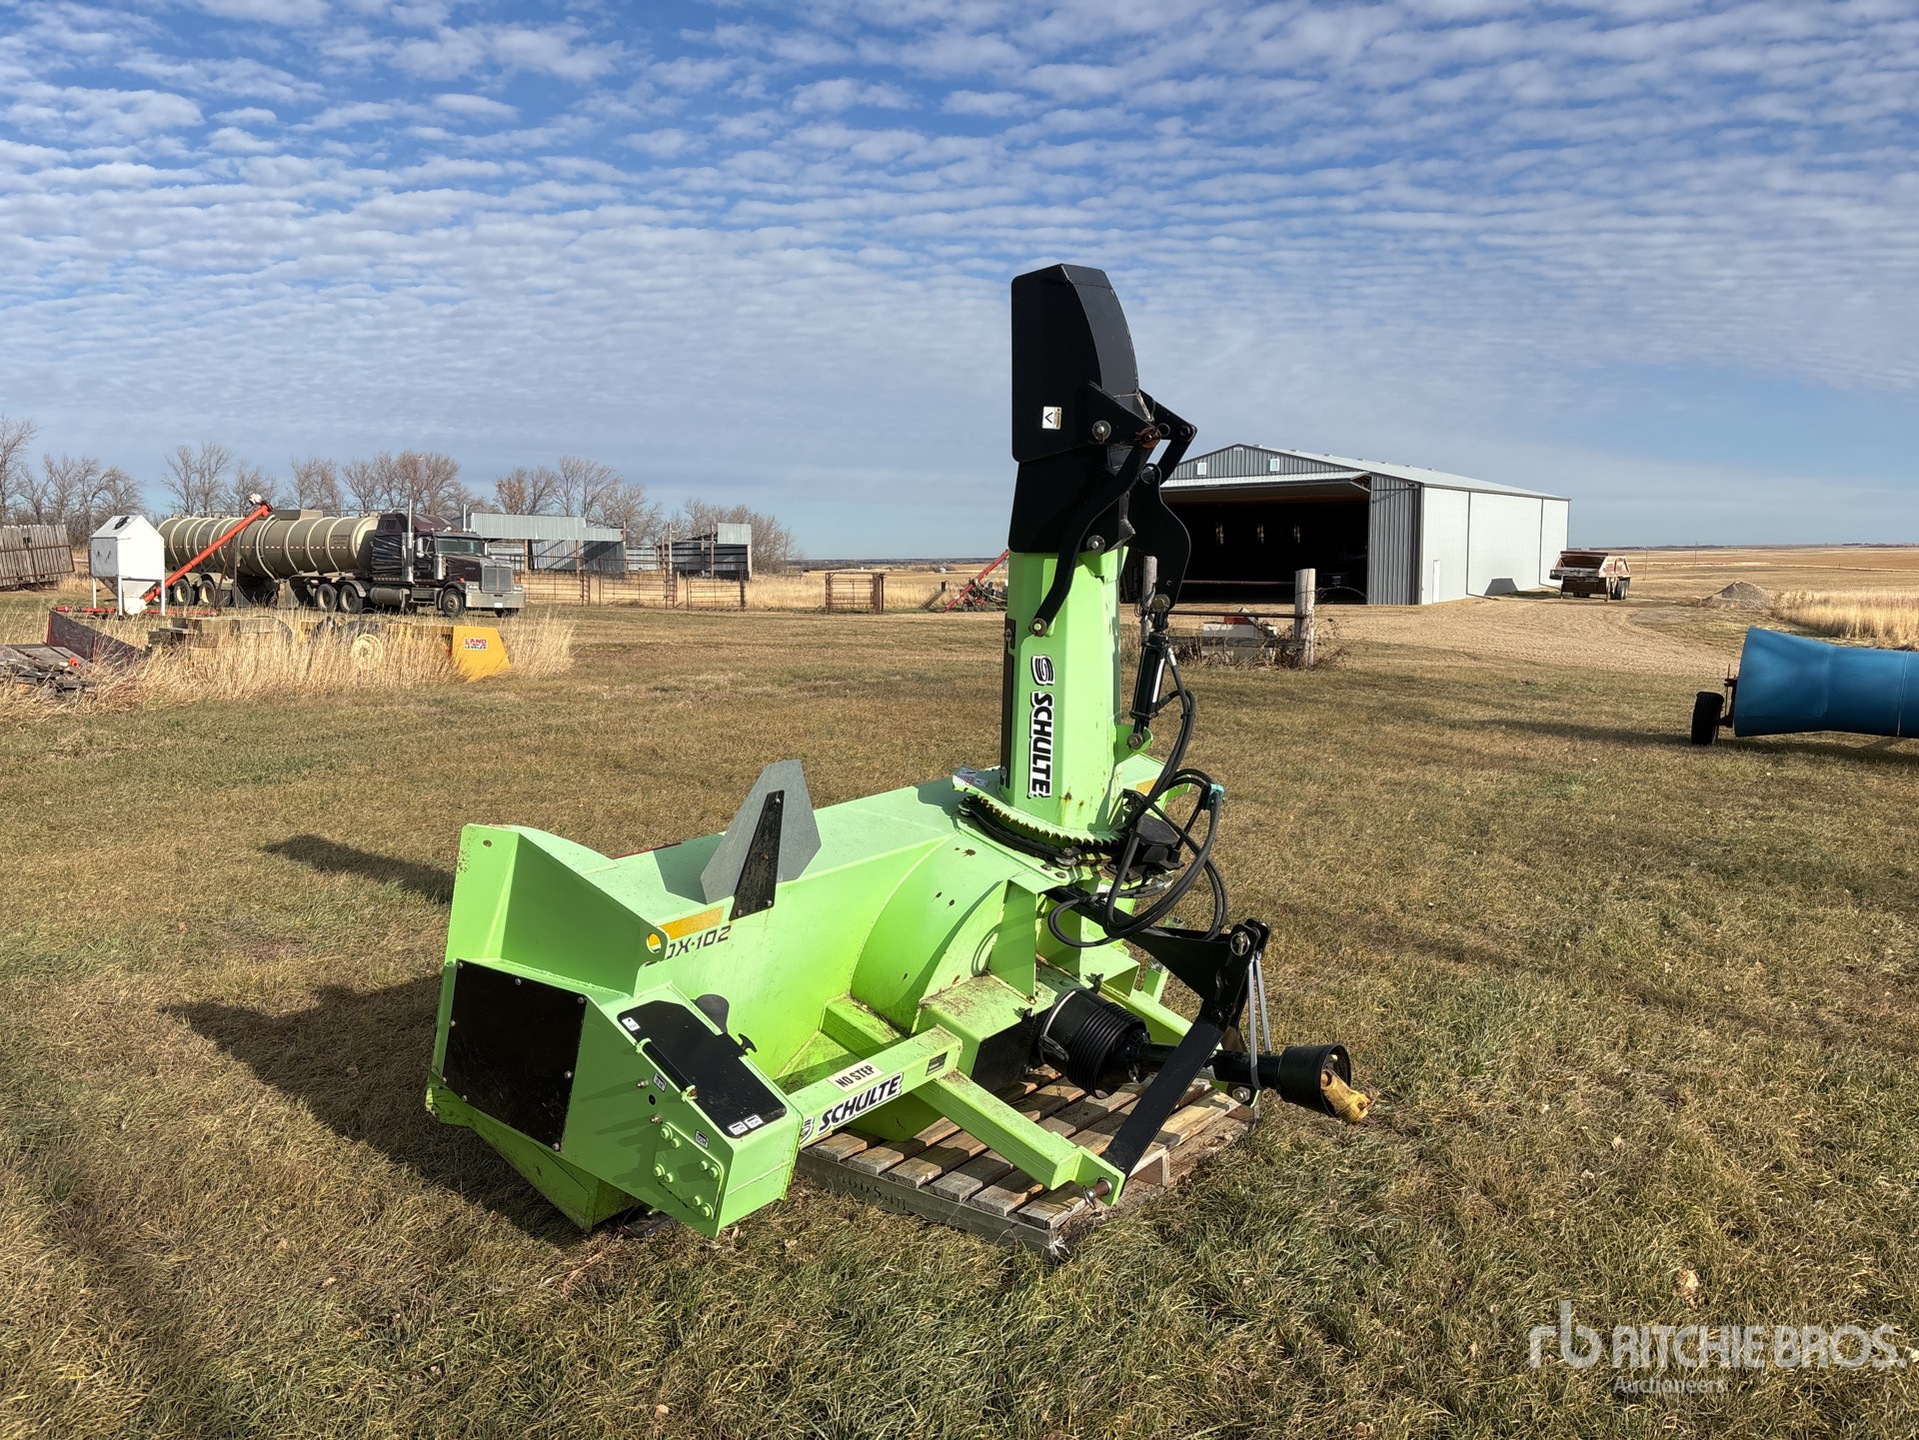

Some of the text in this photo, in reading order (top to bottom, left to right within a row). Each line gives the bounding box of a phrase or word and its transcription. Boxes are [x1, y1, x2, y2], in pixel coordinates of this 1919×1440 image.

[1031, 692, 1054, 796] SCHULTE
[818, 1075, 902, 1132] SCHULTE
[835, 1065, 875, 1088] NO STEP
